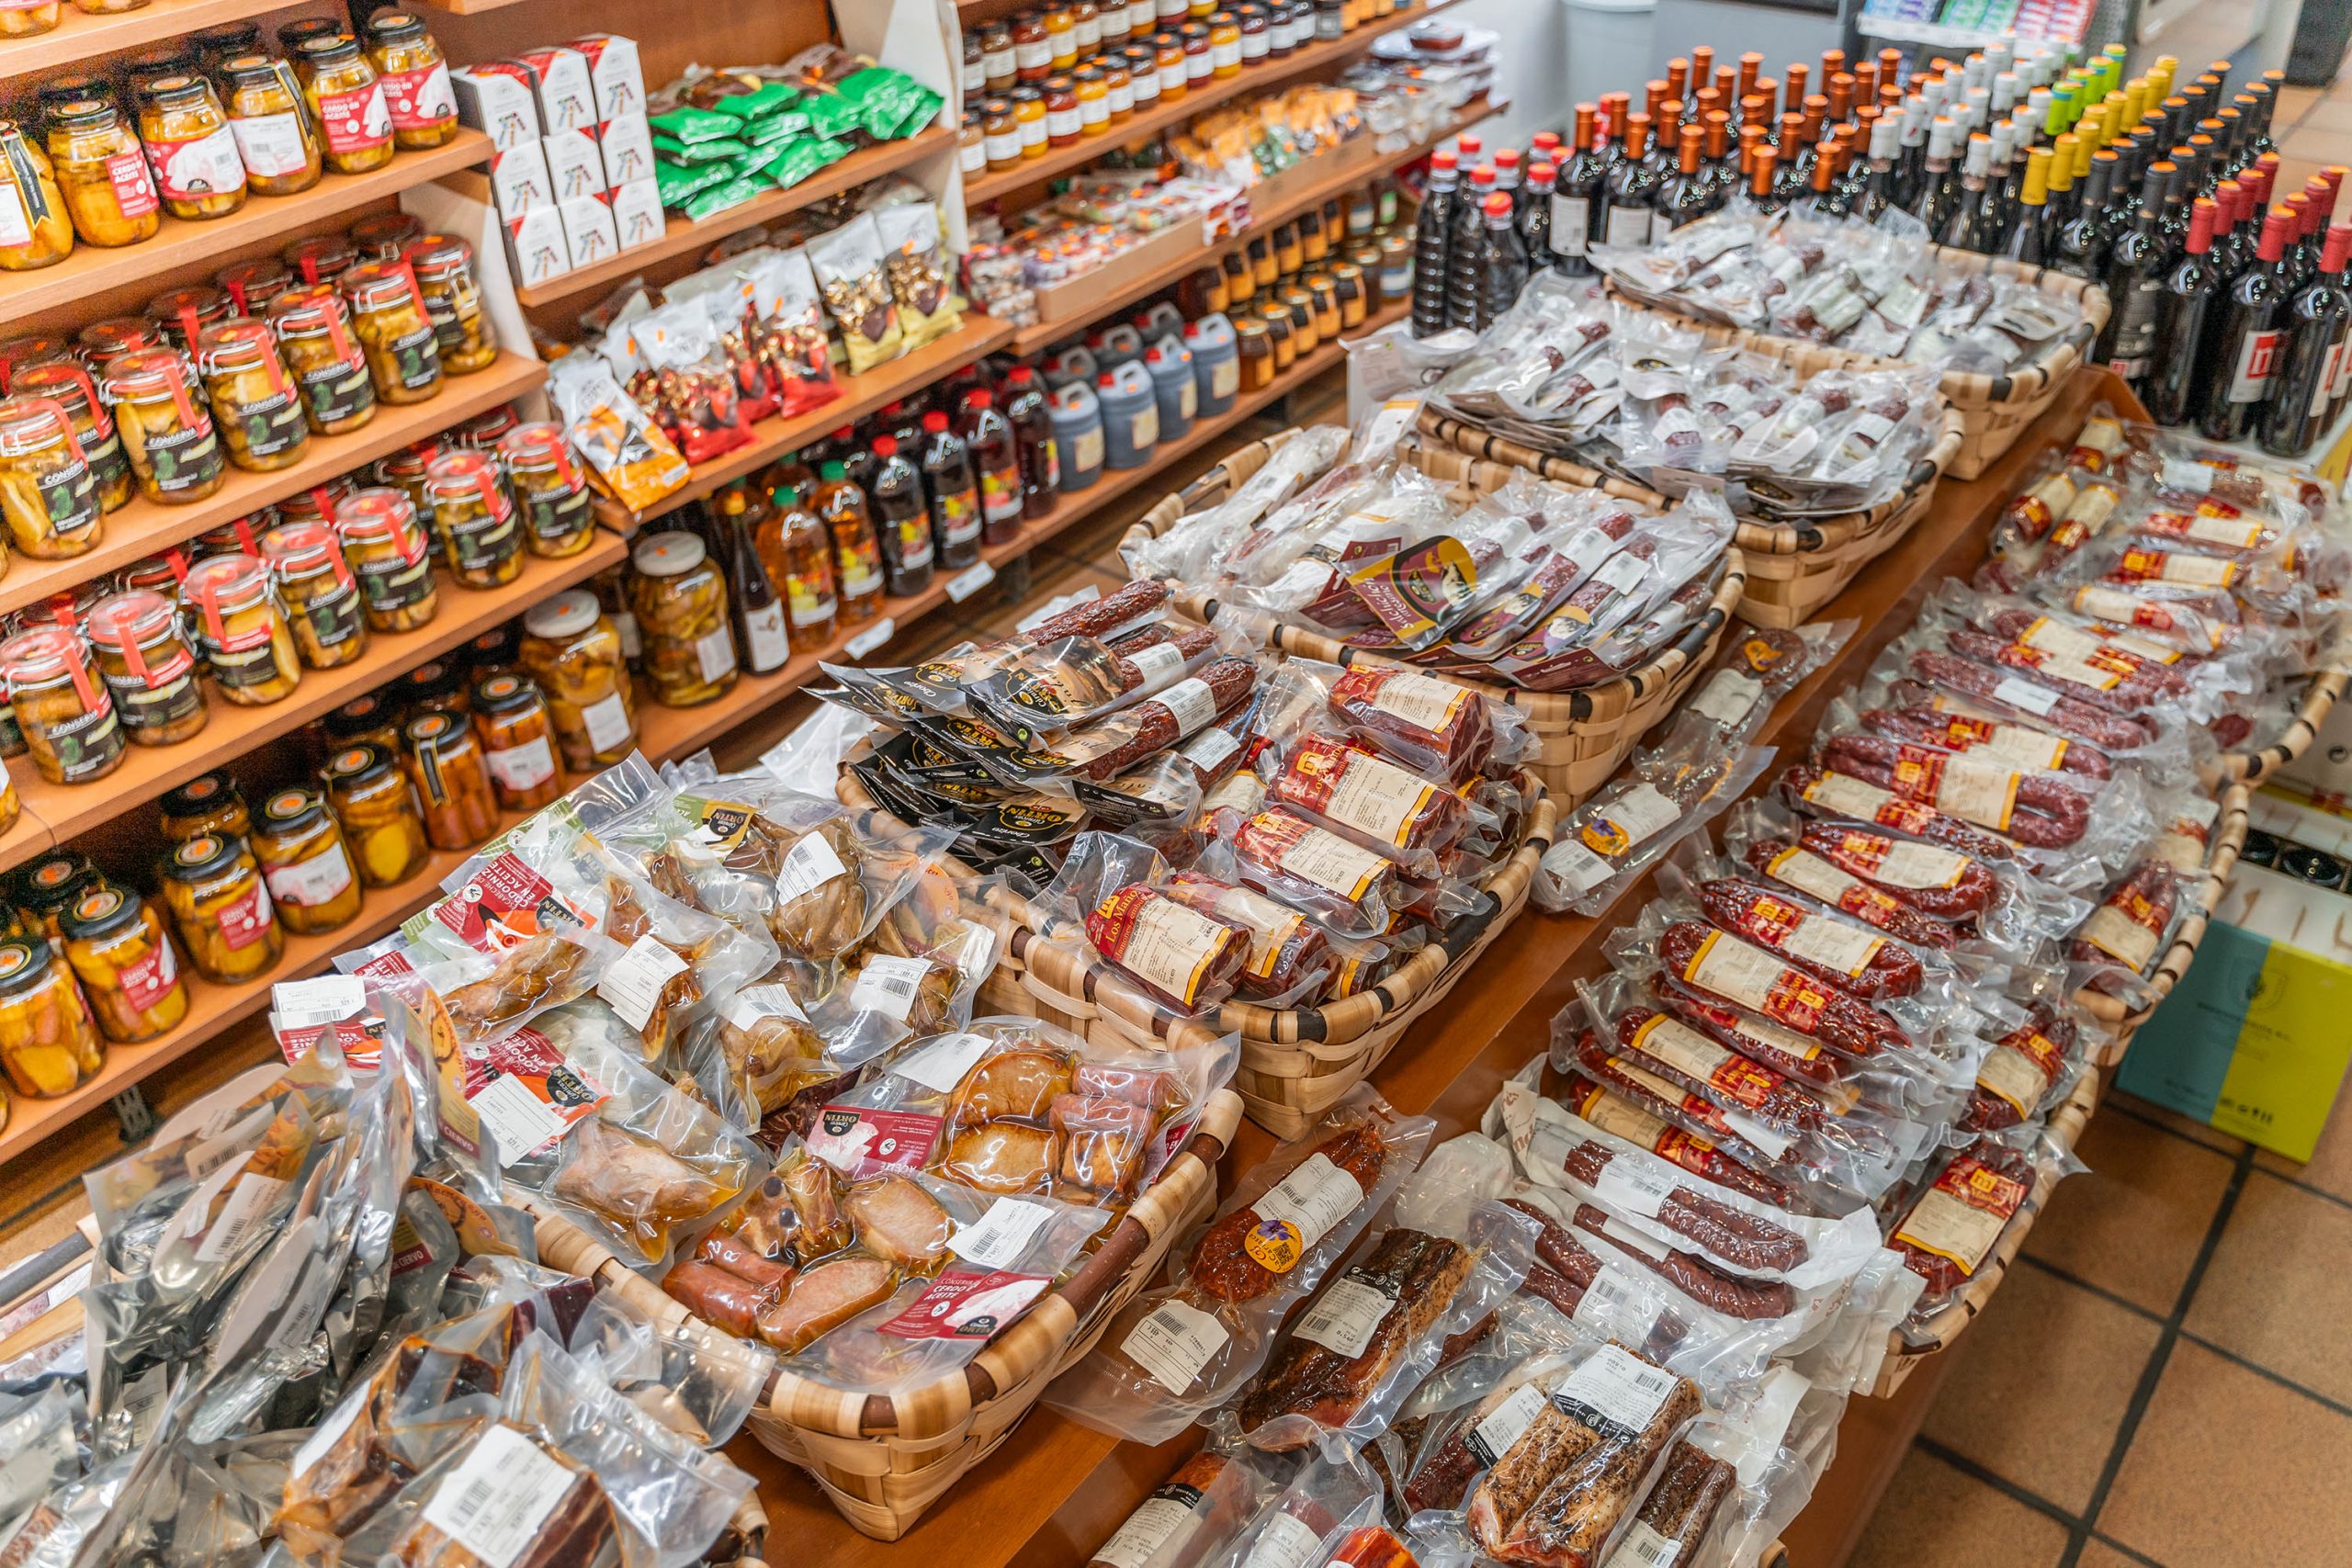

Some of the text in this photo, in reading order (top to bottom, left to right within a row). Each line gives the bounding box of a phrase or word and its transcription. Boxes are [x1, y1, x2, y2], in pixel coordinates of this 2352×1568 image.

[712, 812, 743, 823] ORTIN
[1004, 807, 1063, 824] ORTIN
[991, 827, 1031, 840] Chorizo
[490, 860, 523, 888] ACEITE
[481, 866, 530, 908] CODORNIZ
[1103, 919, 1122, 942] Los
[530, 1051, 547, 1066] EN
[553, 1065, 592, 1101] ORTIN
[824, 1113, 856, 1122] ORTIN
[444, 1127, 475, 1153] CIERVO
[398, 1249, 424, 1267] CIERVO
[923, 1292, 958, 1301] ACEITE
